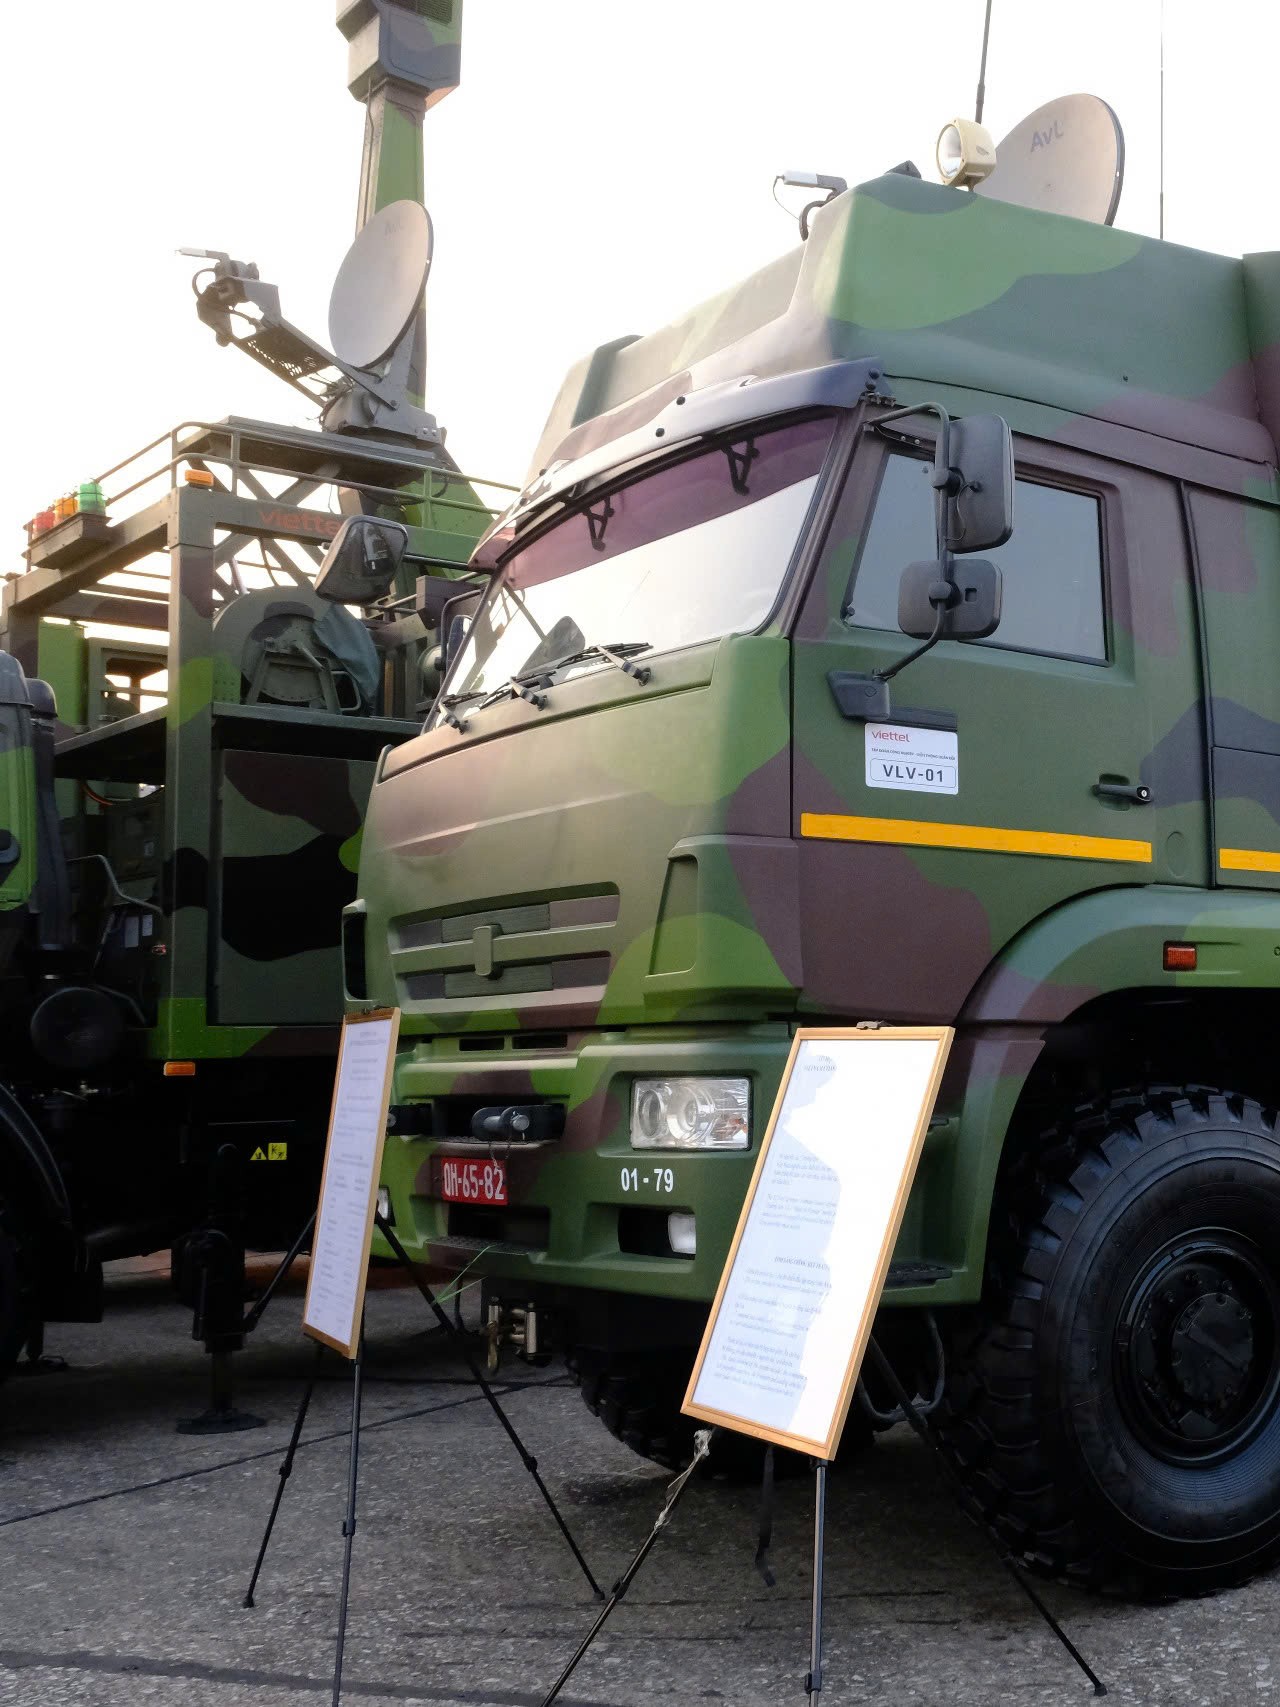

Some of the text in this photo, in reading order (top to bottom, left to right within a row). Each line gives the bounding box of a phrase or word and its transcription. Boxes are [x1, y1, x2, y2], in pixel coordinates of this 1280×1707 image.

[261, 510, 343, 536] viette
[871, 730, 910, 743] viettel
[883, 764, 943, 782] VLV-01
